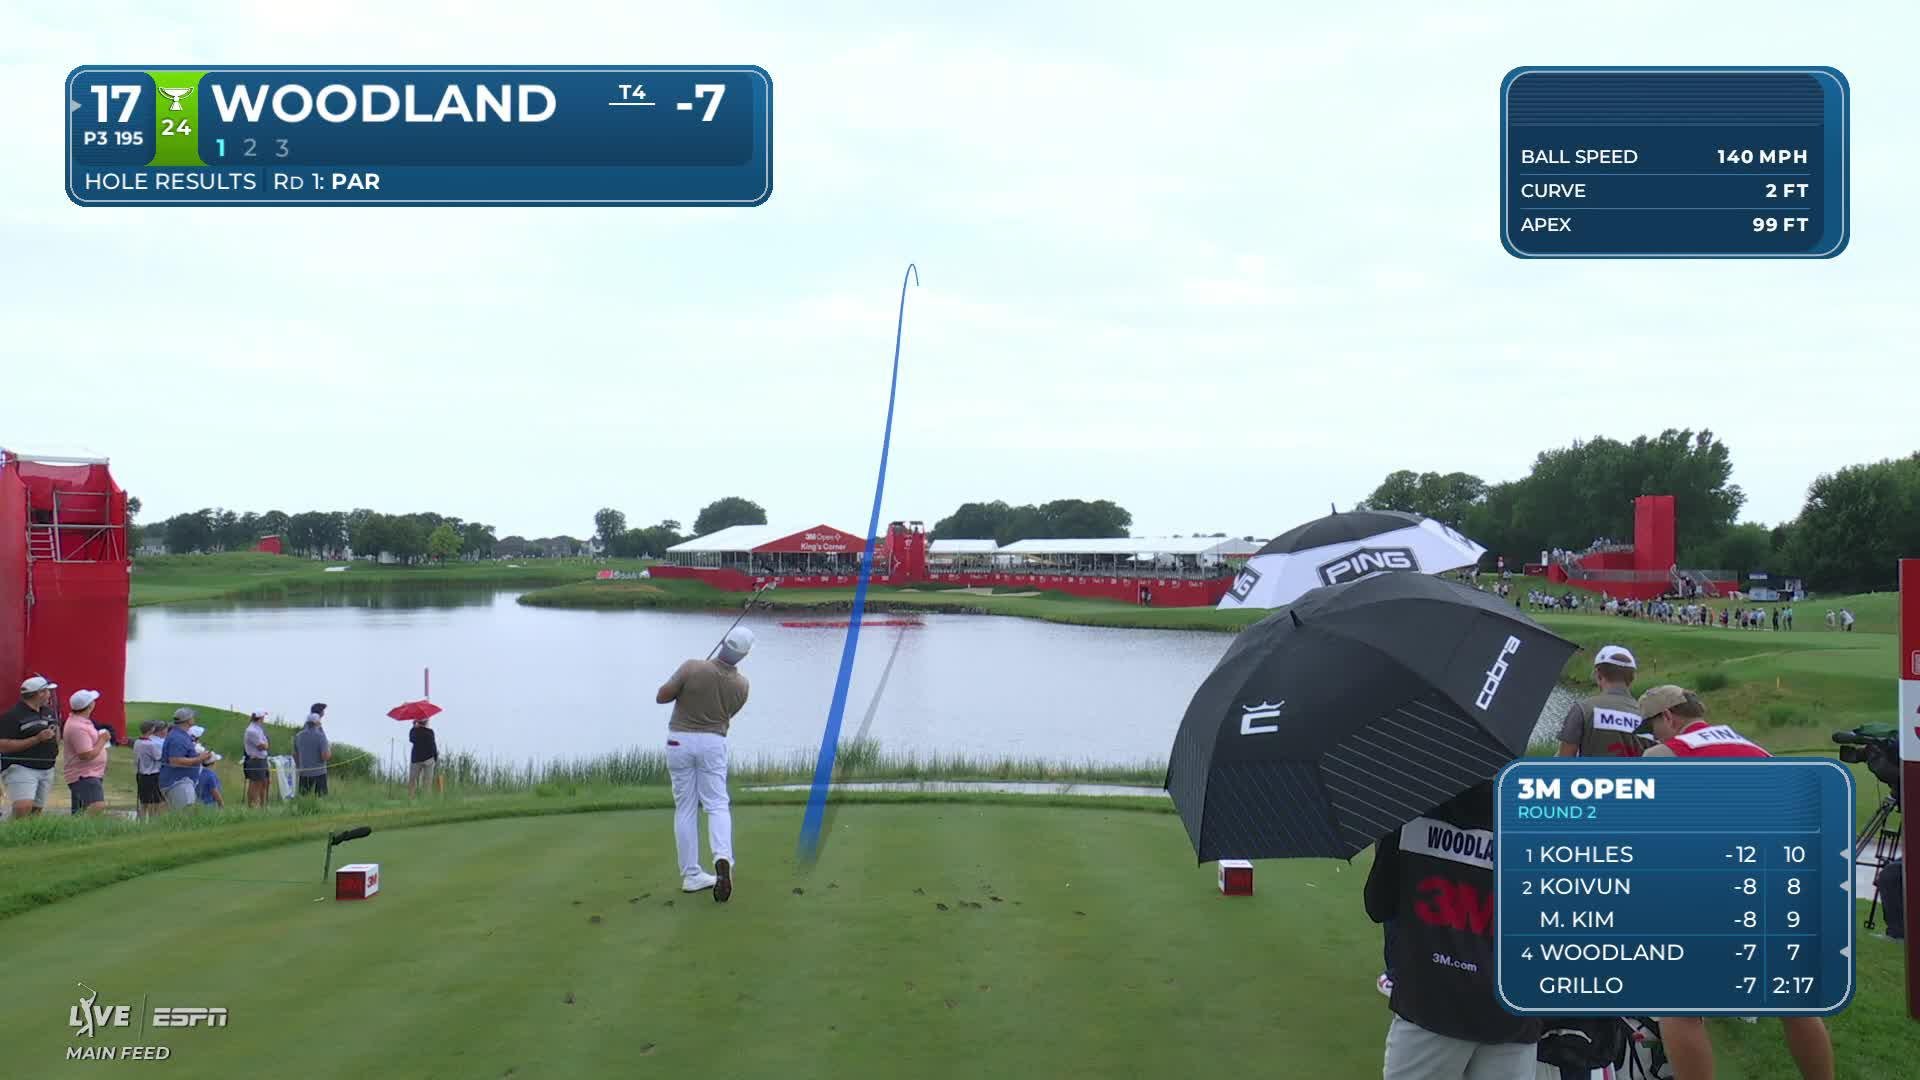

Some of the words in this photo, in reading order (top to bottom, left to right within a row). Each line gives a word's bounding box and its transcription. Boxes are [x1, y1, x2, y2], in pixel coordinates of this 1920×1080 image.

[822, 543, 847, 551] Corner
[1326, 551, 1412, 585] PING
[1475, 634, 1522, 711] cobra
[1431, 952, 1478, 973] 3M.com
